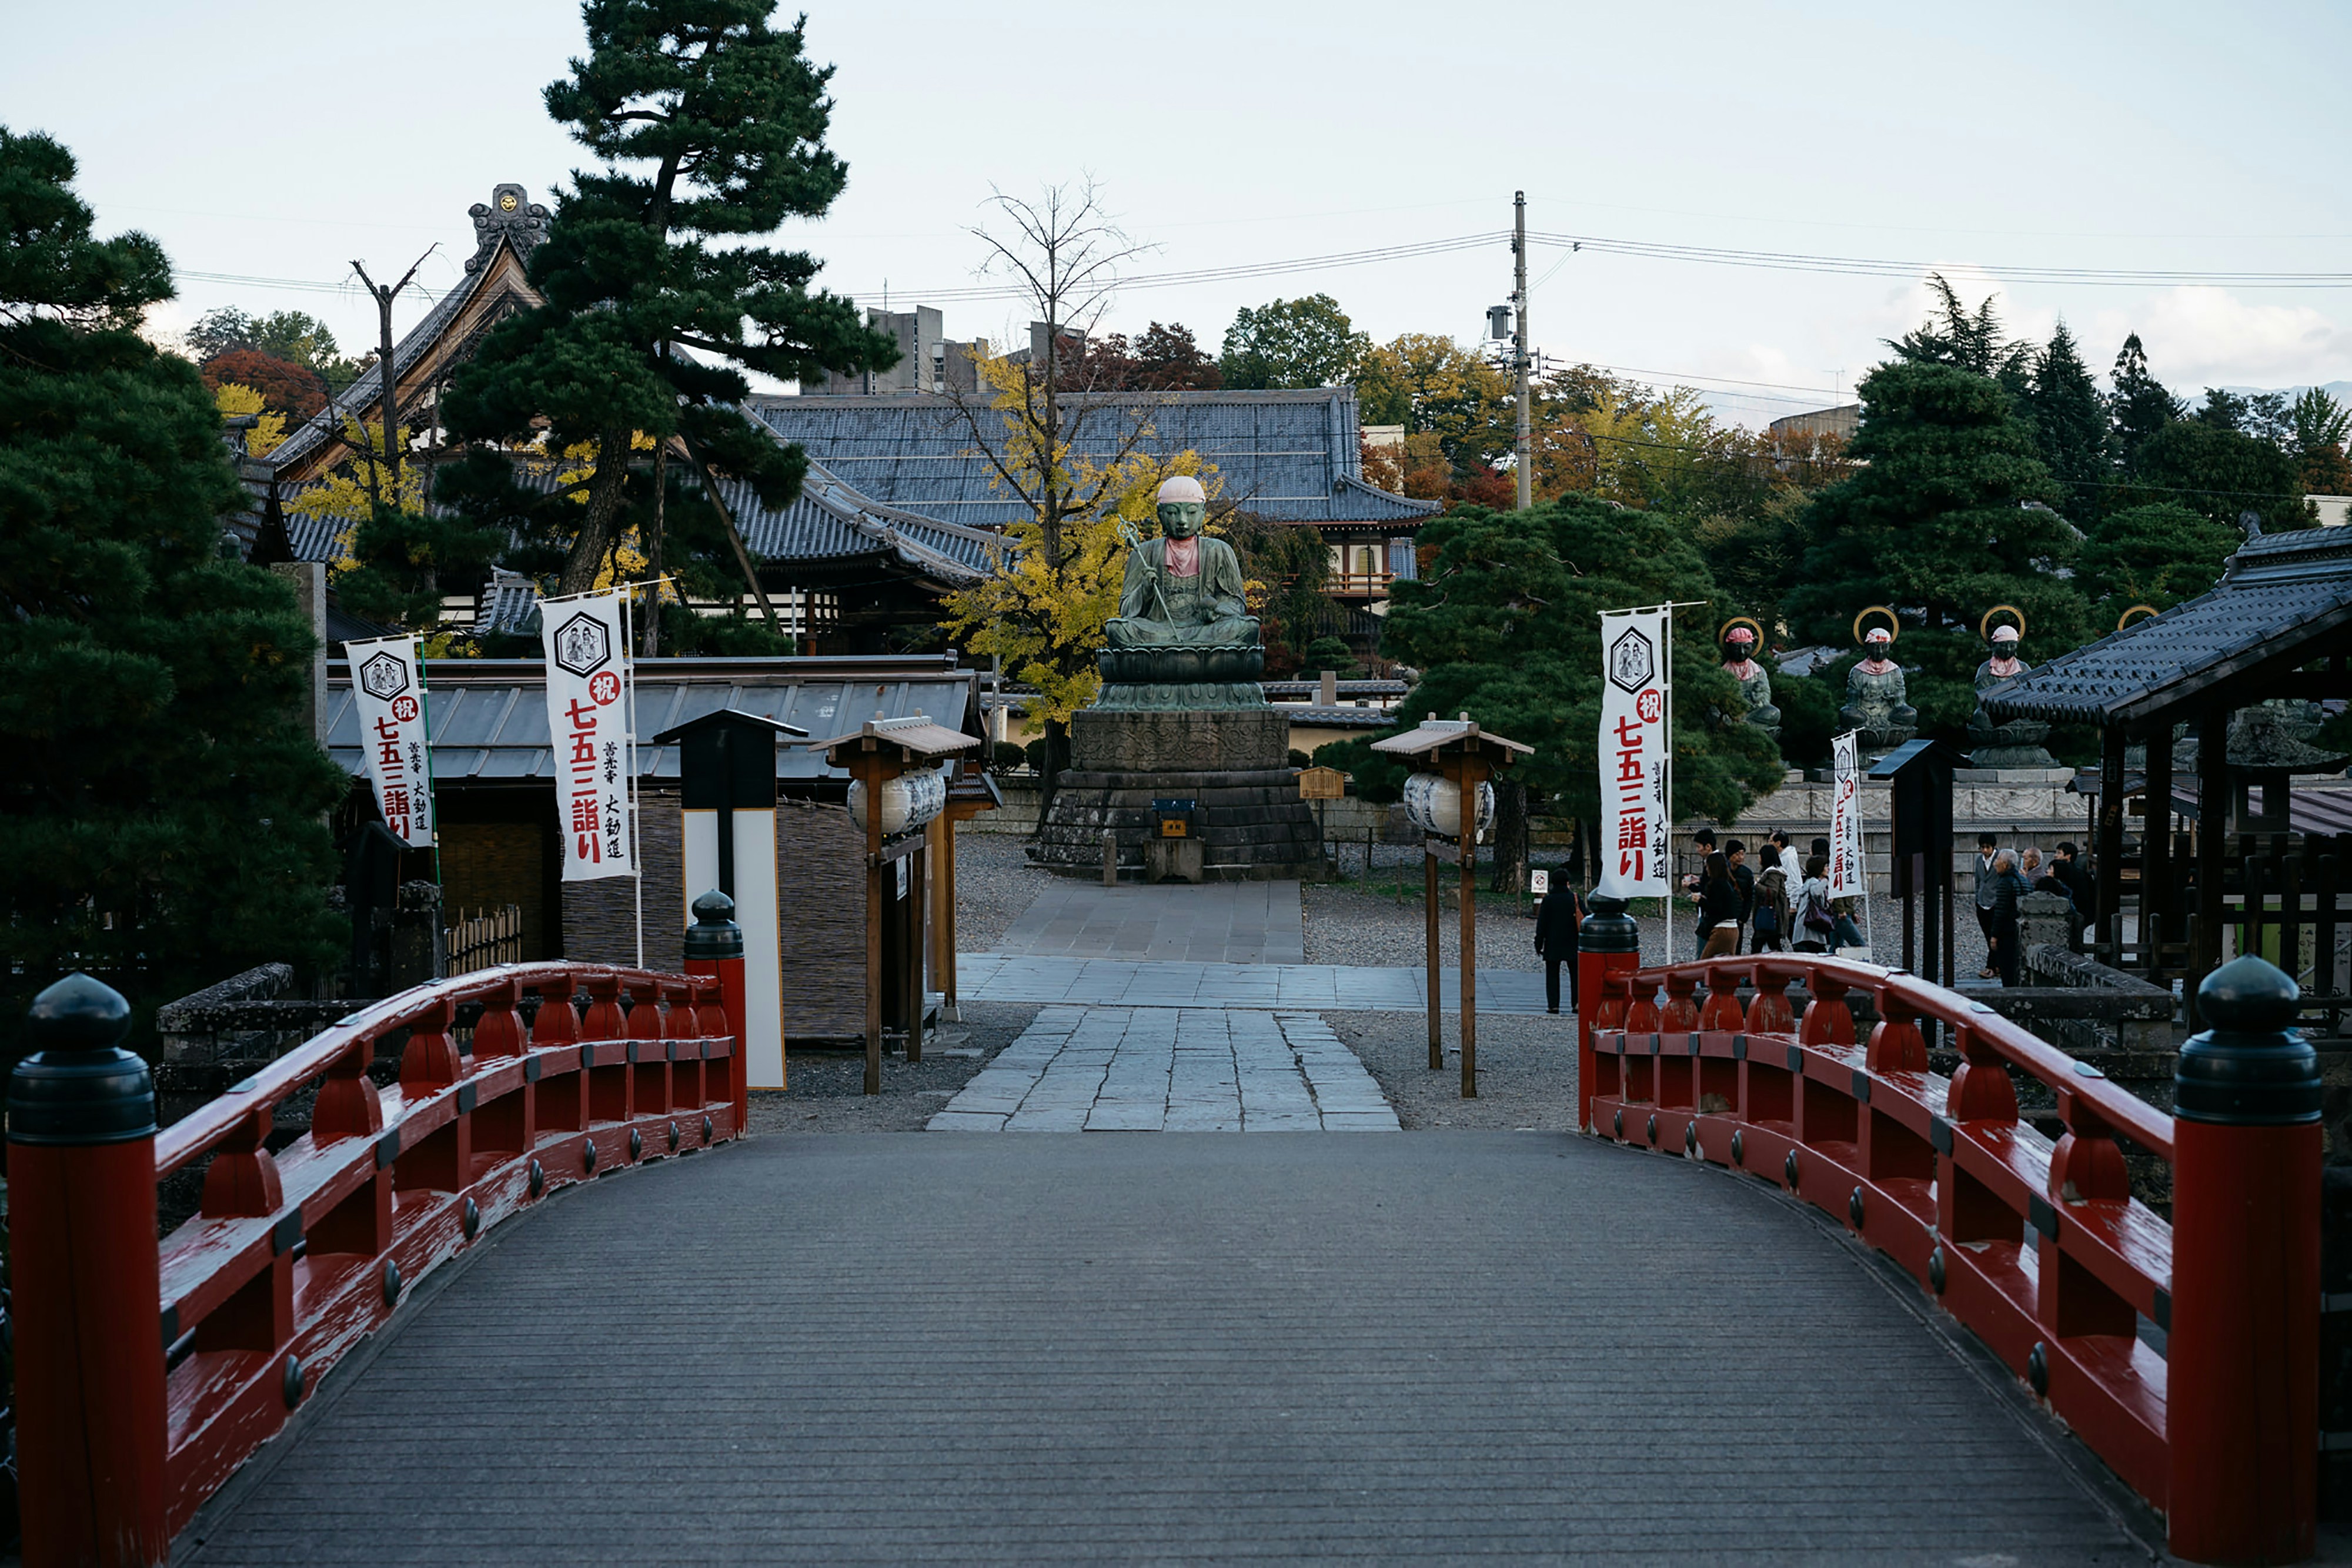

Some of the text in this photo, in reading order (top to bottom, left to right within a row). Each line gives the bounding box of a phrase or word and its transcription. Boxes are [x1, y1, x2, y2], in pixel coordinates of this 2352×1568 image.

[395, 699, 415, 718] 祝
[592, 676, 616, 701] 祝
[1639, 693, 1661, 719] 祝
[373, 717, 410, 840] 七五三詣り
[564, 698, 600, 864] 七五三詣り
[1613, 716, 1647, 881] 七五三詣り
